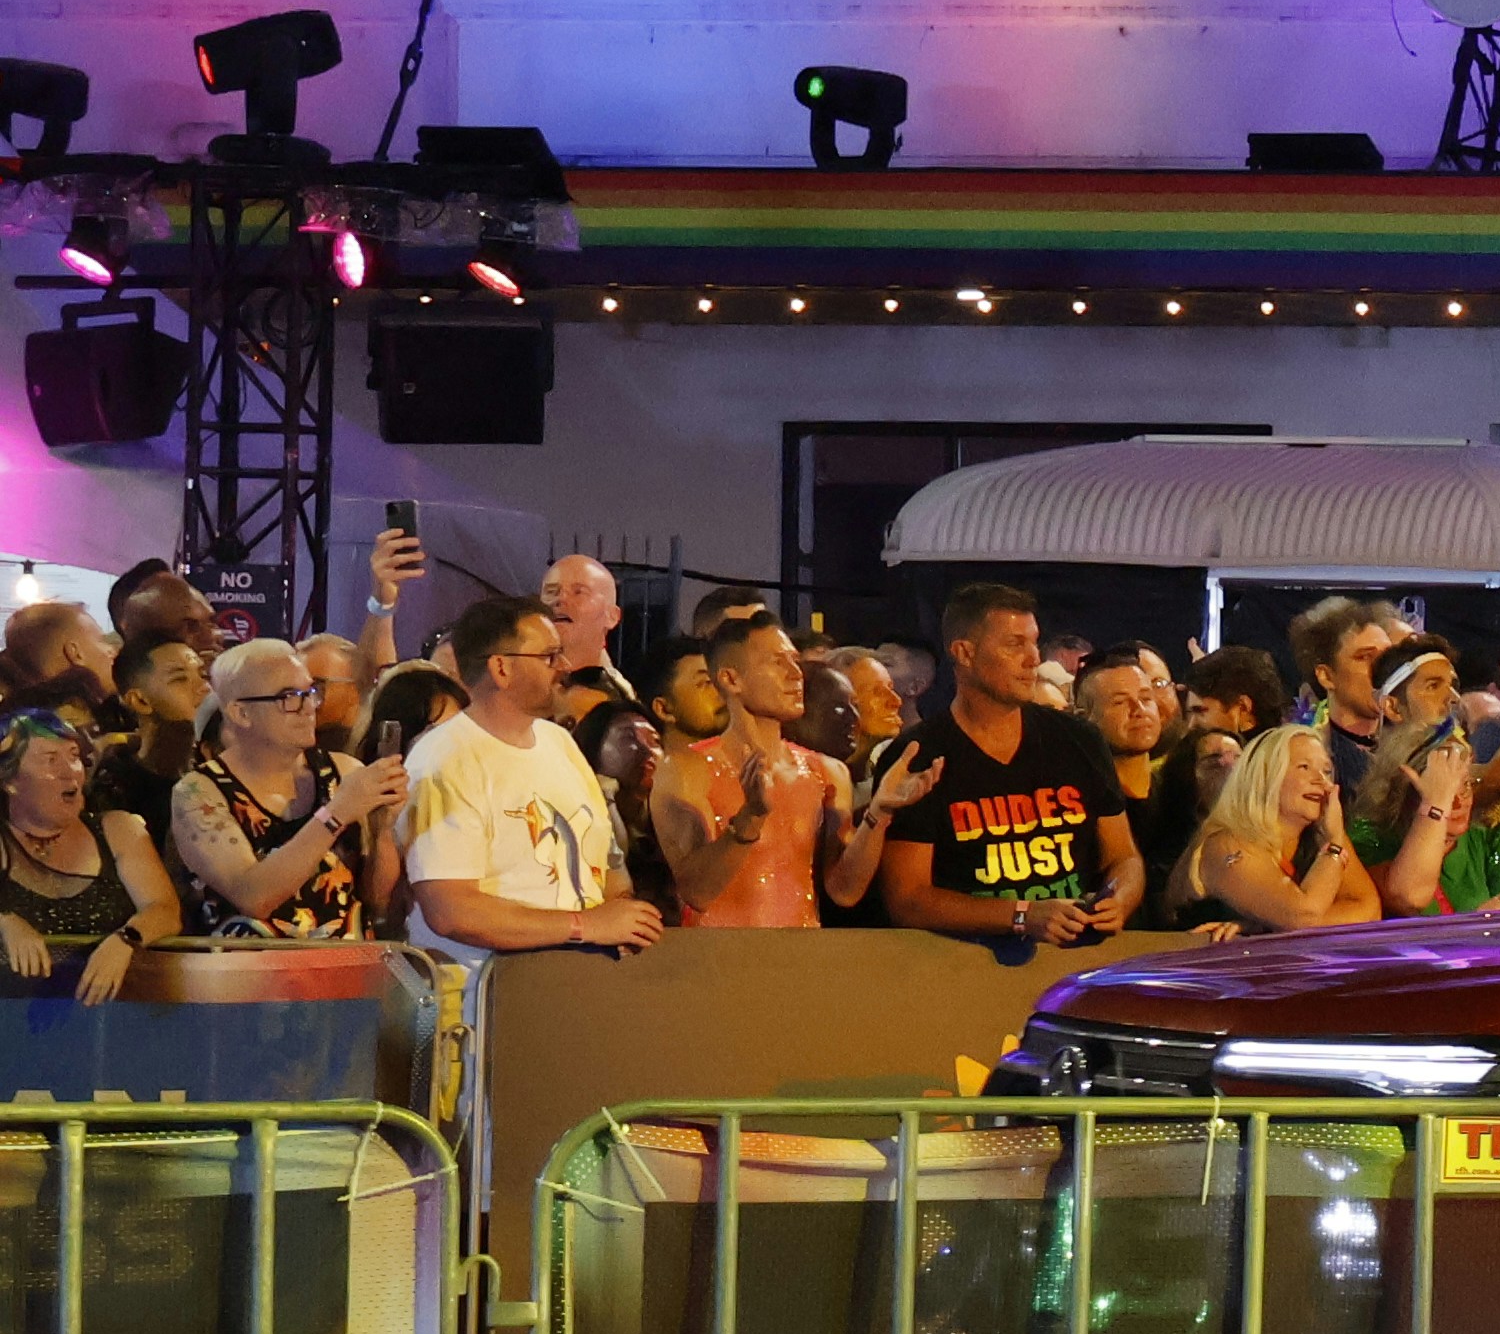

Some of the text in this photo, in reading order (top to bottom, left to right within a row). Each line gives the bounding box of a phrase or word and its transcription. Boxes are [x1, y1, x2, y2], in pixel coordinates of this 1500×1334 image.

[221, 571, 253, 588] NO
[205, 592, 266, 603] SMOKING
[950, 785, 1087, 842] DUDES
[975, 832, 1075, 885] JUST
